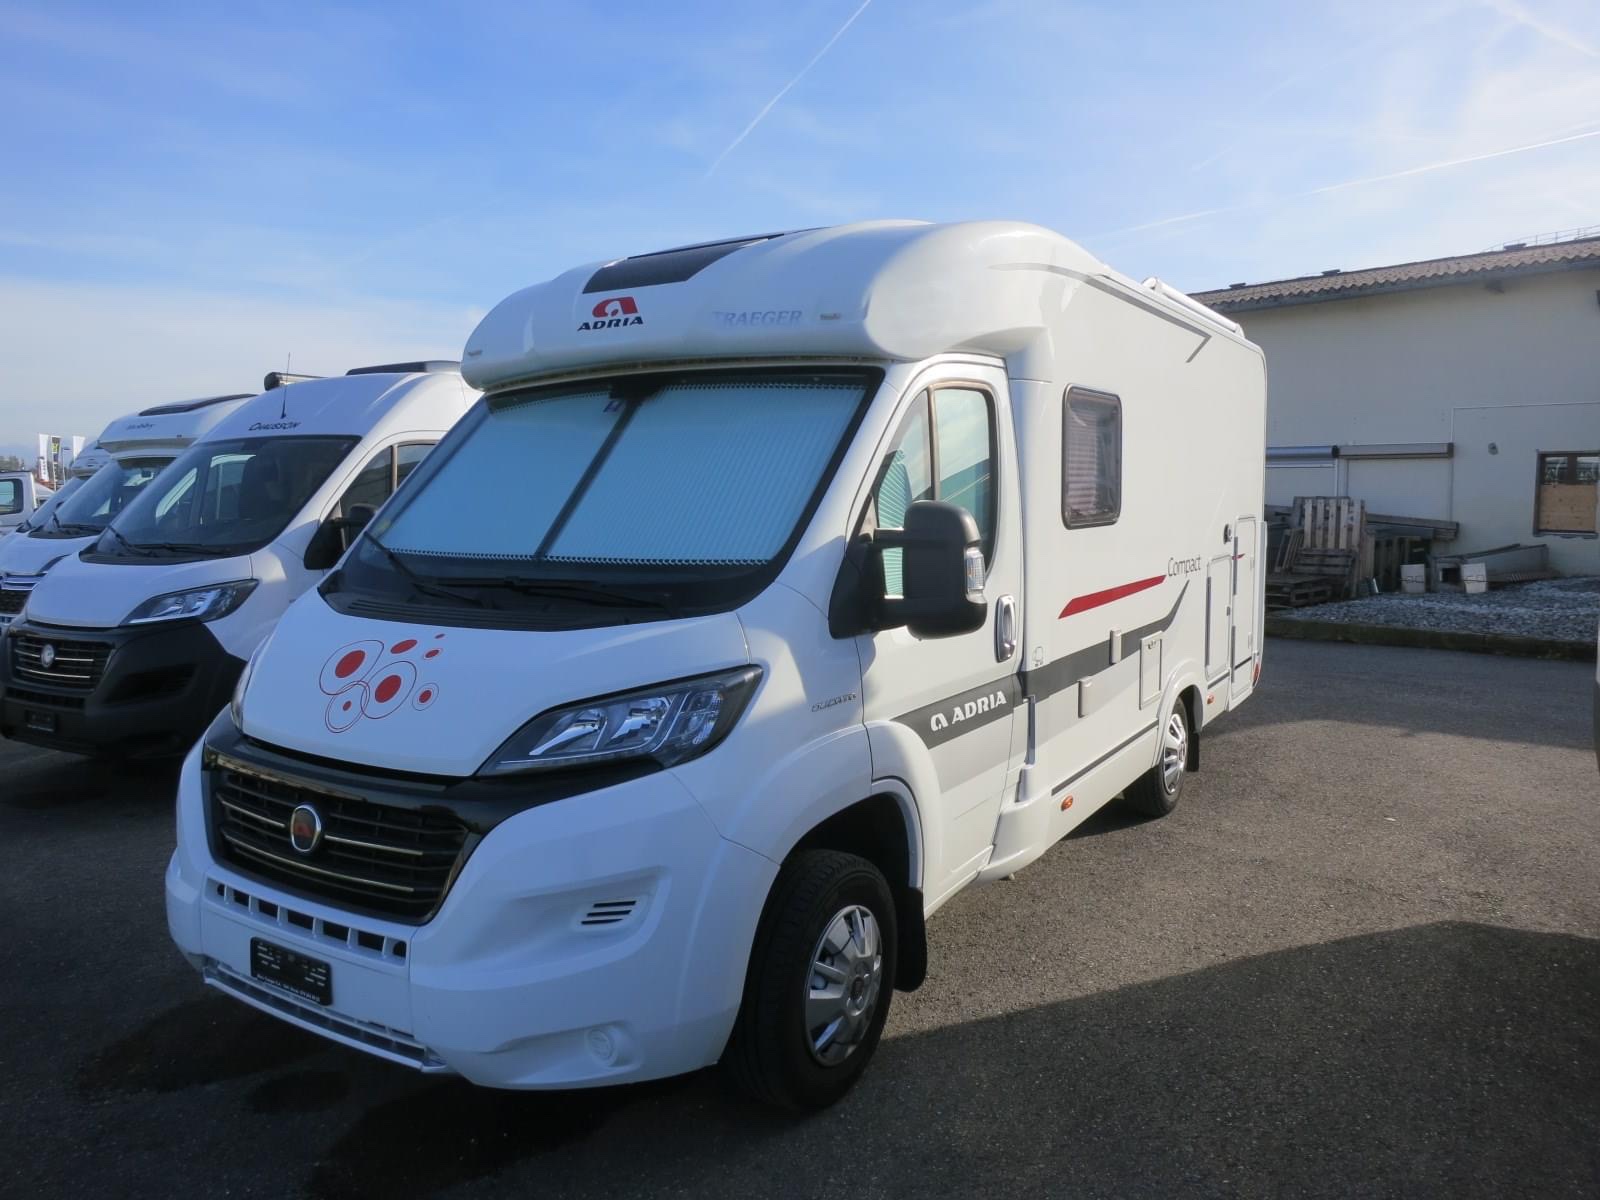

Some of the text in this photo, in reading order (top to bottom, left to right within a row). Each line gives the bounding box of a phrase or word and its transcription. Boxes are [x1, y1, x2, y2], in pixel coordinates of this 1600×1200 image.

[577, 316, 644, 332] ADRIA
[1167, 555, 1201, 577] Compact
[951, 690, 1007, 725] ADRIA
